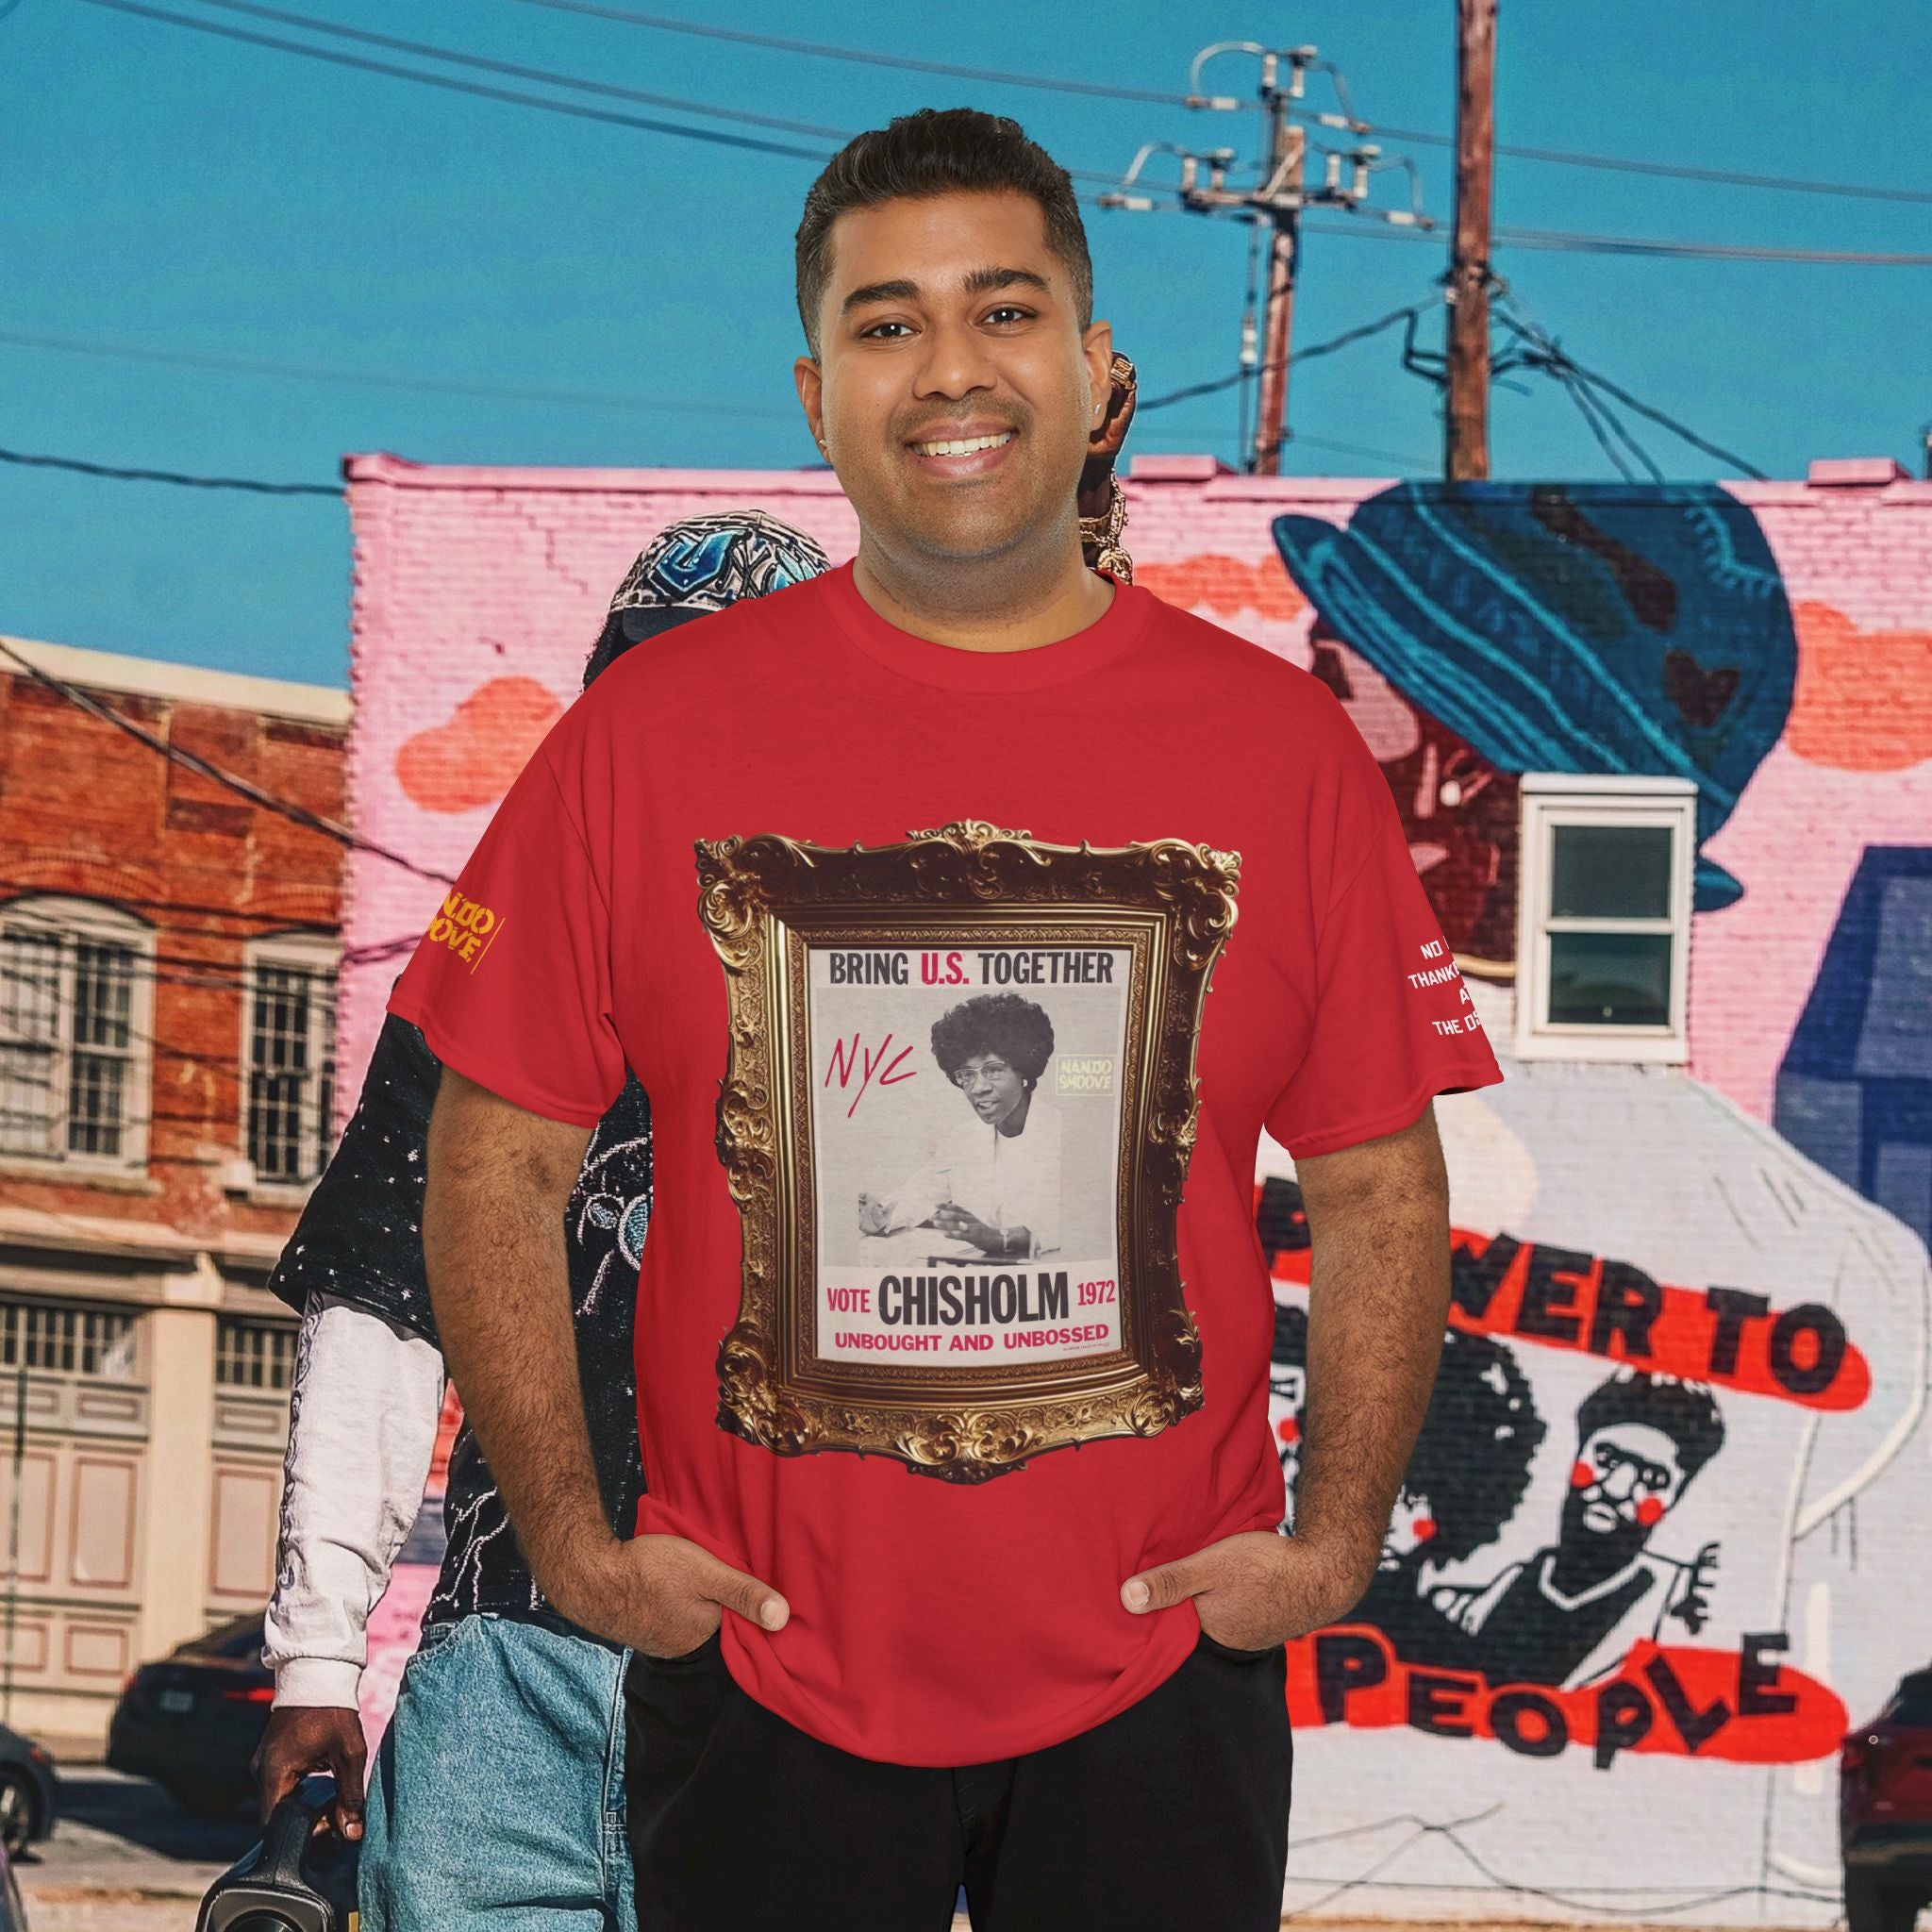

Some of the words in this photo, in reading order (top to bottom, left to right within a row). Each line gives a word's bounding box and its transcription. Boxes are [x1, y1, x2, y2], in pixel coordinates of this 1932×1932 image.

[1420, 940, 1443, 959] NO
[829, 952, 908, 985] BRING
[921, 952, 970, 985] U.S.
[977, 951, 1114, 985] TOGETHER
[1432, 1019, 1463, 1036] THE
[824, 1032, 917, 1119] NYC
[1058, 1074, 1112, 1090] SMOOVE
[826, 1287, 871, 1313] VOTE
[878, 1271, 1070, 1326] CHISHOLM
[1076, 1279, 1116, 1307] 1972
[1256, 1176, 1662, 1357] PWER
[1706, 1286, 1849, 1395] TO
[834, 1332, 942, 1352] UNBOUGHT
[948, 1334, 994, 1352] AND
[1003, 1324, 1109, 1350] UNBOSSED
[1315, 1632, 1799, 1771] PEOPLE
